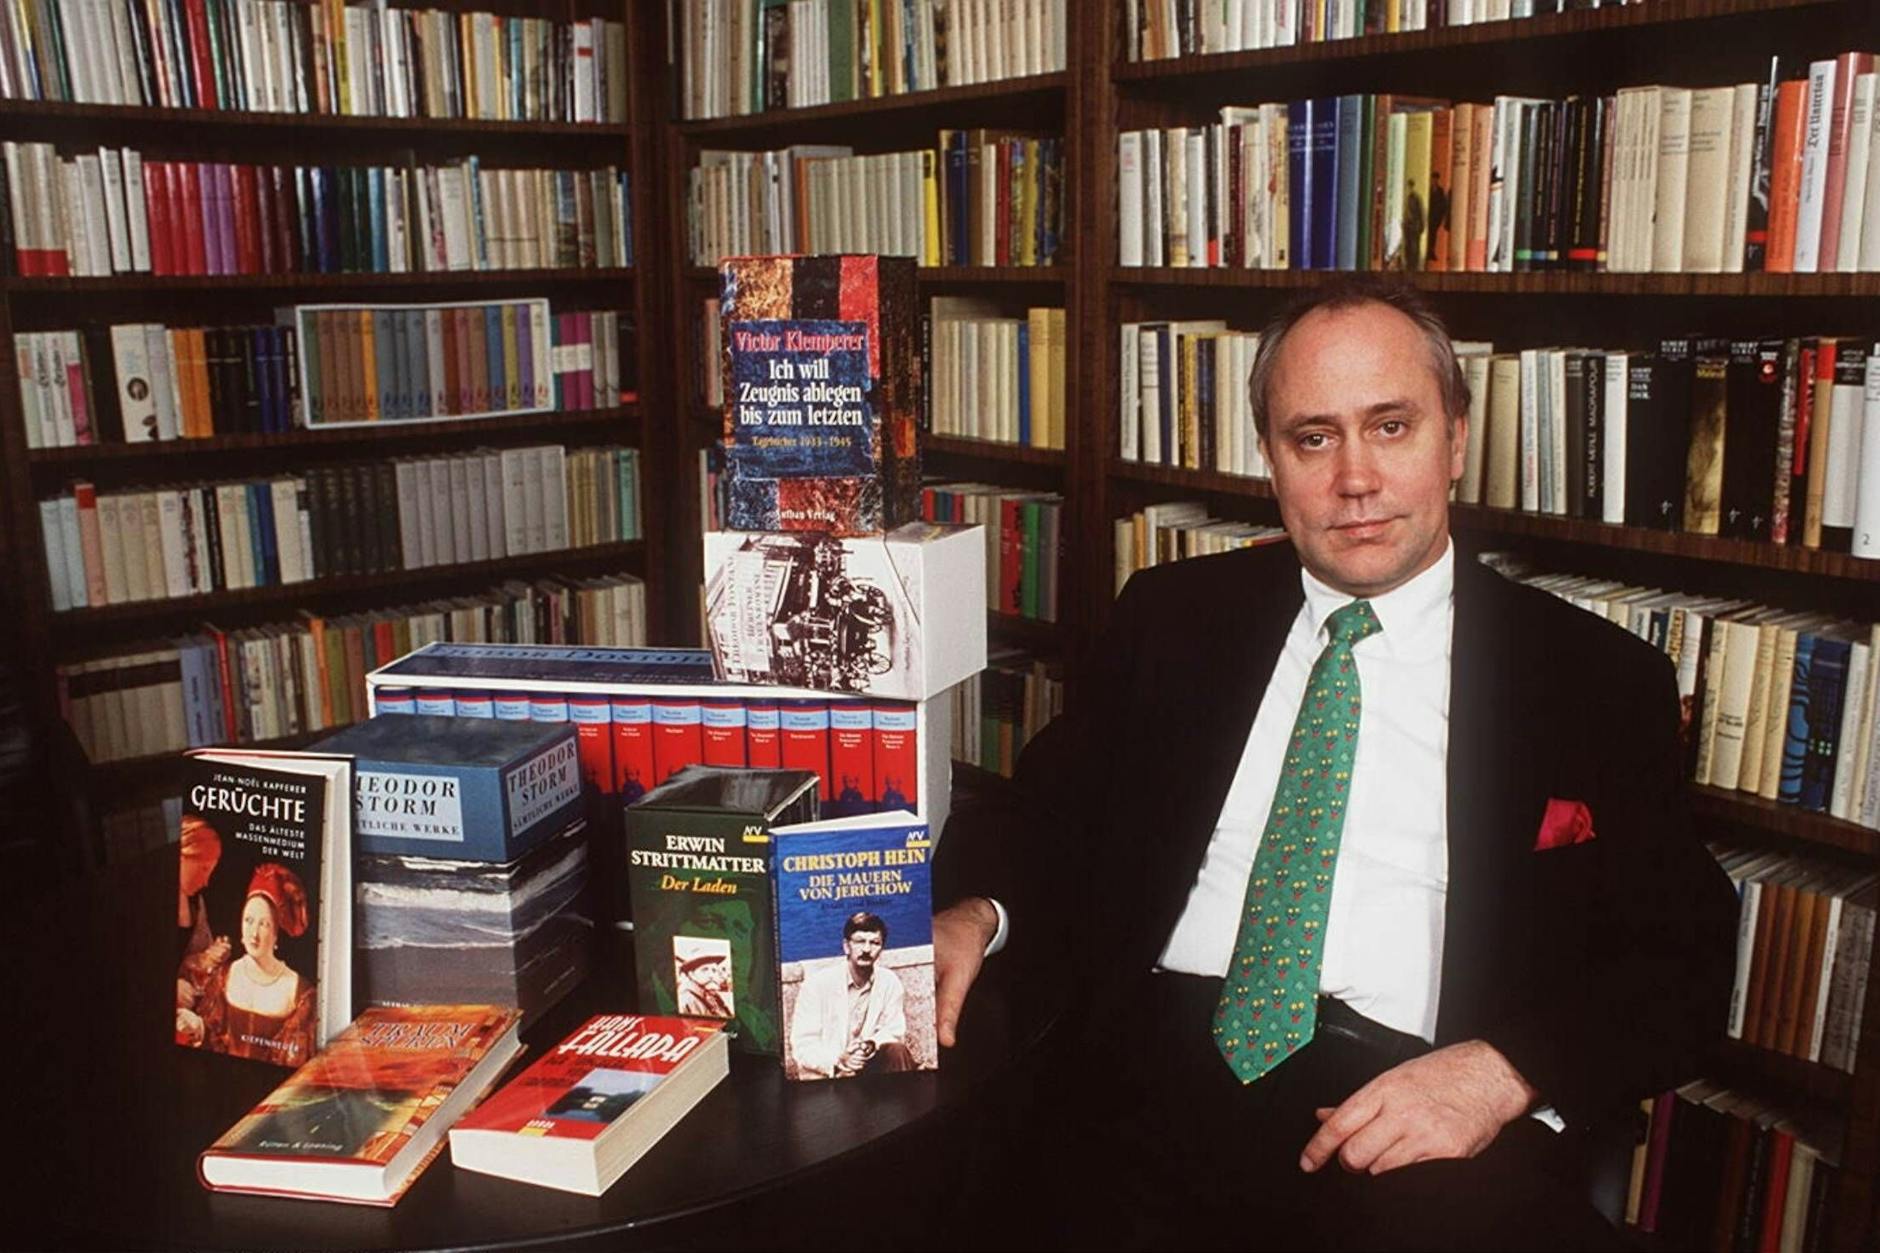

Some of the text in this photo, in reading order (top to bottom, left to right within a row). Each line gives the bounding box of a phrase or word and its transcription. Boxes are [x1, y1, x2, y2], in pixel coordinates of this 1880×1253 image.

[735, 331, 864, 355] Victor Klemperer
[769, 359, 829, 379] Ich will
[740, 382, 862, 407] Zeugnis ablegen
[740, 406, 863, 425] bis zum letzten
[806, 508, 836, 522] Verlag
[1862, 533, 1870, 546] 2
[510, 742, 576, 793] THEODOR
[263, 781, 307, 794] KAPFERER
[356, 776, 455, 799] EODOR
[521, 766, 568, 806] STORM
[191, 785, 305, 823] GERÜCHTE
[356, 795, 436, 816] STORM
[249, 823, 266, 833] DAS
[360, 819, 460, 836] TLICHE WERKE
[235, 832, 305, 849] MASSENMEDIUM
[666, 835, 725, 853] ERWIN
[262, 846, 305, 860] DER WELT
[631, 850, 766, 873] STRITTMATTER
[783, 848, 926, 872] CHRISTOPH HEIN
[661, 874, 737, 894] Der Laden
[809, 869, 902, 888] DIE MAUERN
[799, 881, 913, 901] VON JERICHOW
[558, 1031, 700, 1063] FALLADA
